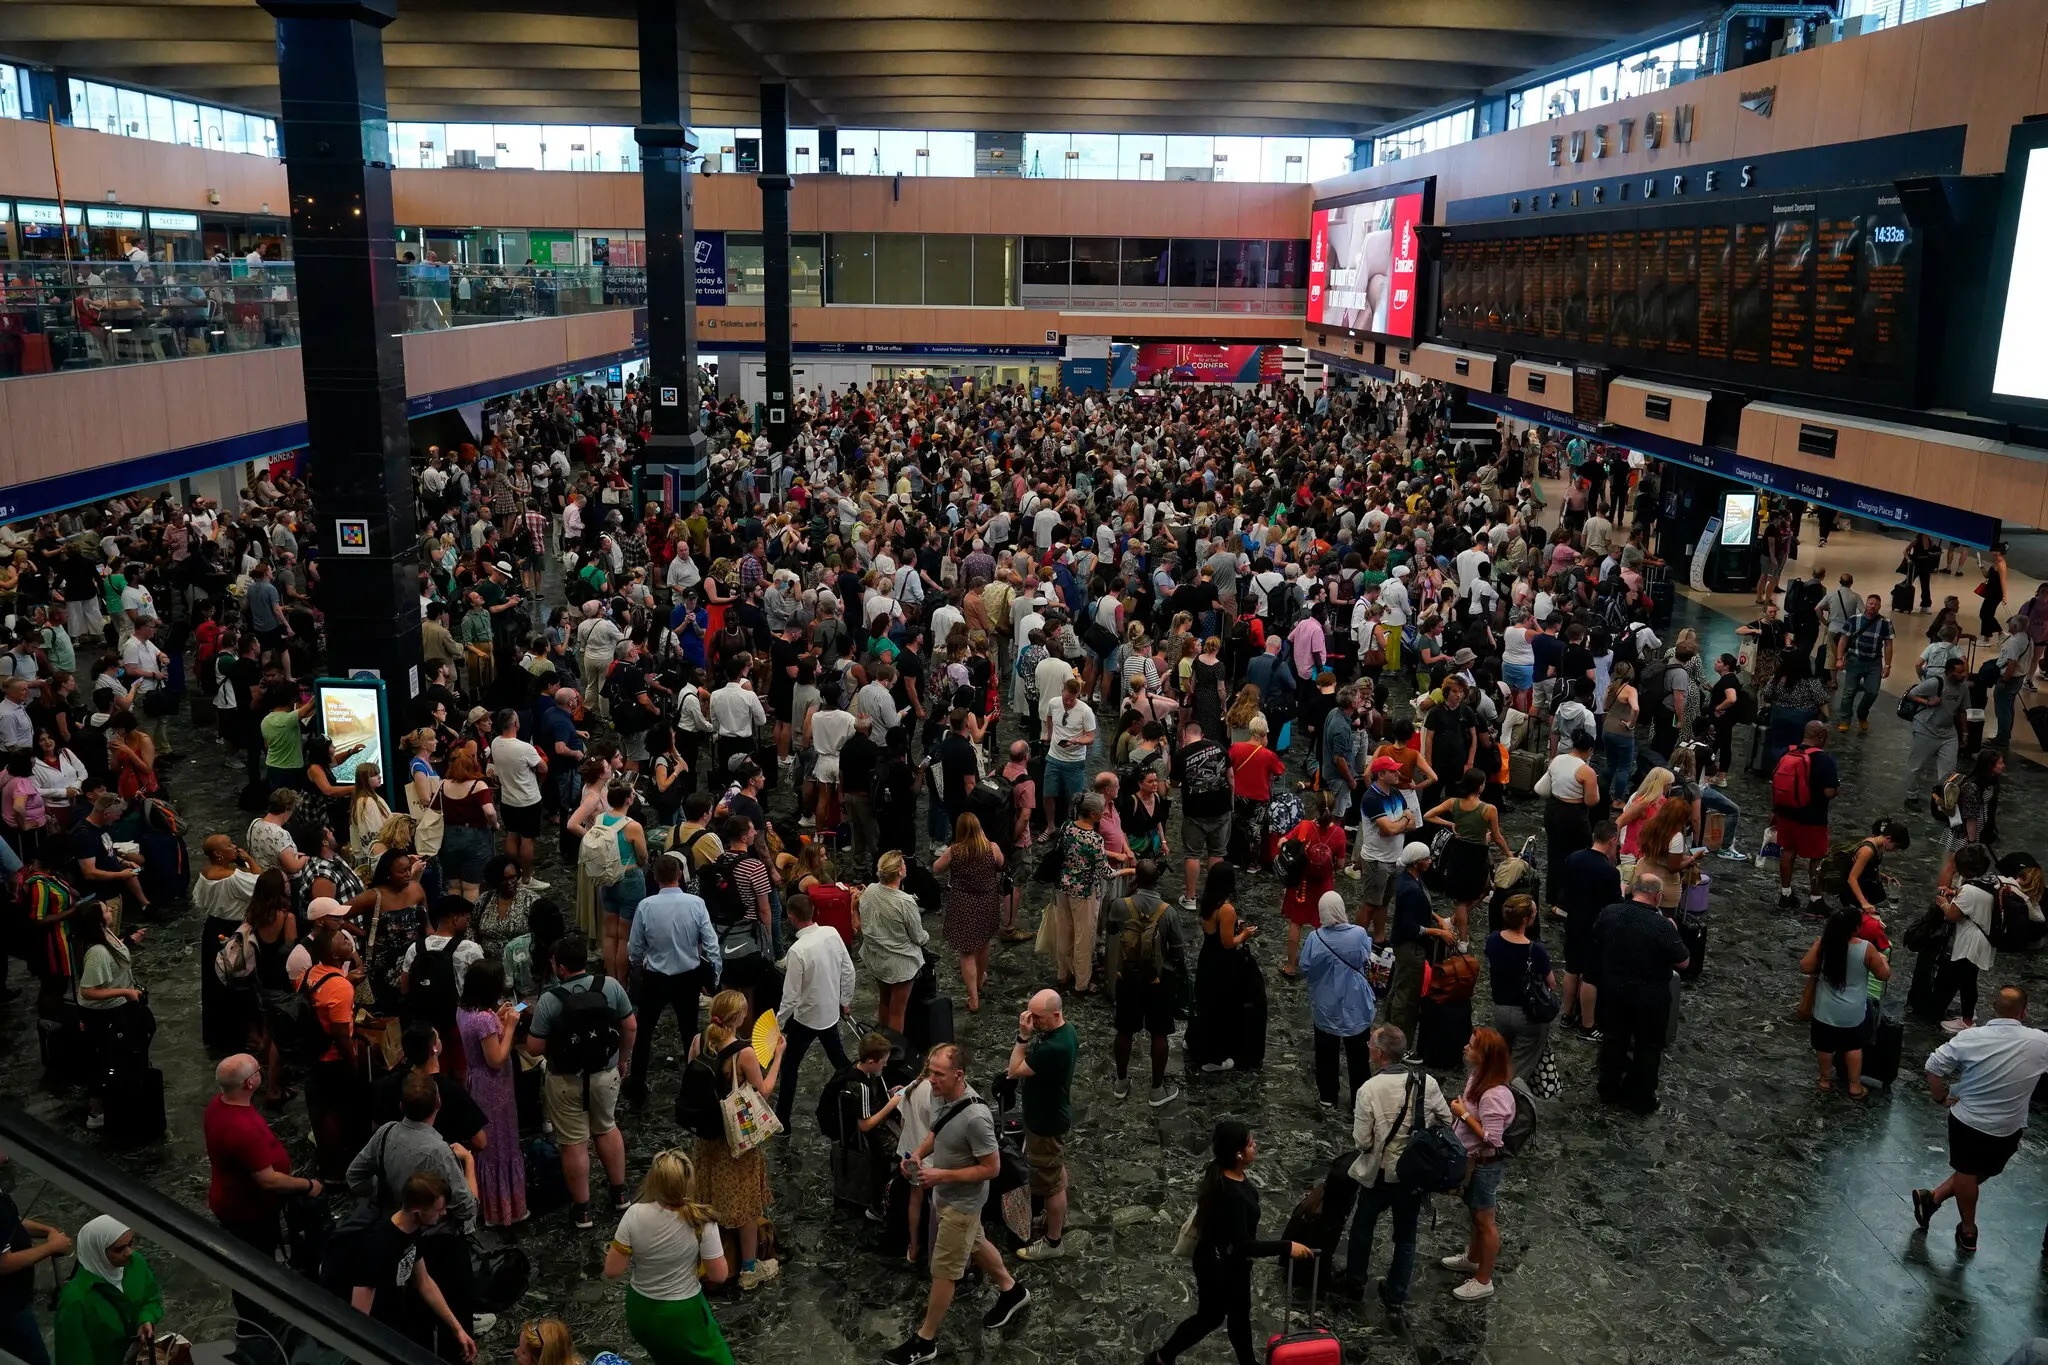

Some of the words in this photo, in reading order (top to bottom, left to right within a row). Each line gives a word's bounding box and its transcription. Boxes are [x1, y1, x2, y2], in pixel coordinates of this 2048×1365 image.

[1548, 103, 1696, 167] EUSTON
[1511, 164, 1755, 214] DEPARTURES
[1794, 203, 1816, 213] Departures
[106, 211, 124, 220] PRIME
[716, 276, 723, 284] &
[704, 287, 725, 295] travel
[1692, 453, 1704, 464] Toilets
[1735, 467, 1750, 480] Changing
[1750, 471, 1763, 482] Places
[1800, 483, 1816, 497] Toilets
[1856, 500, 1877, 516] Changing
[1878, 504, 1894, 518] Places
[1187, 748, 1221, 766] HARRIS
